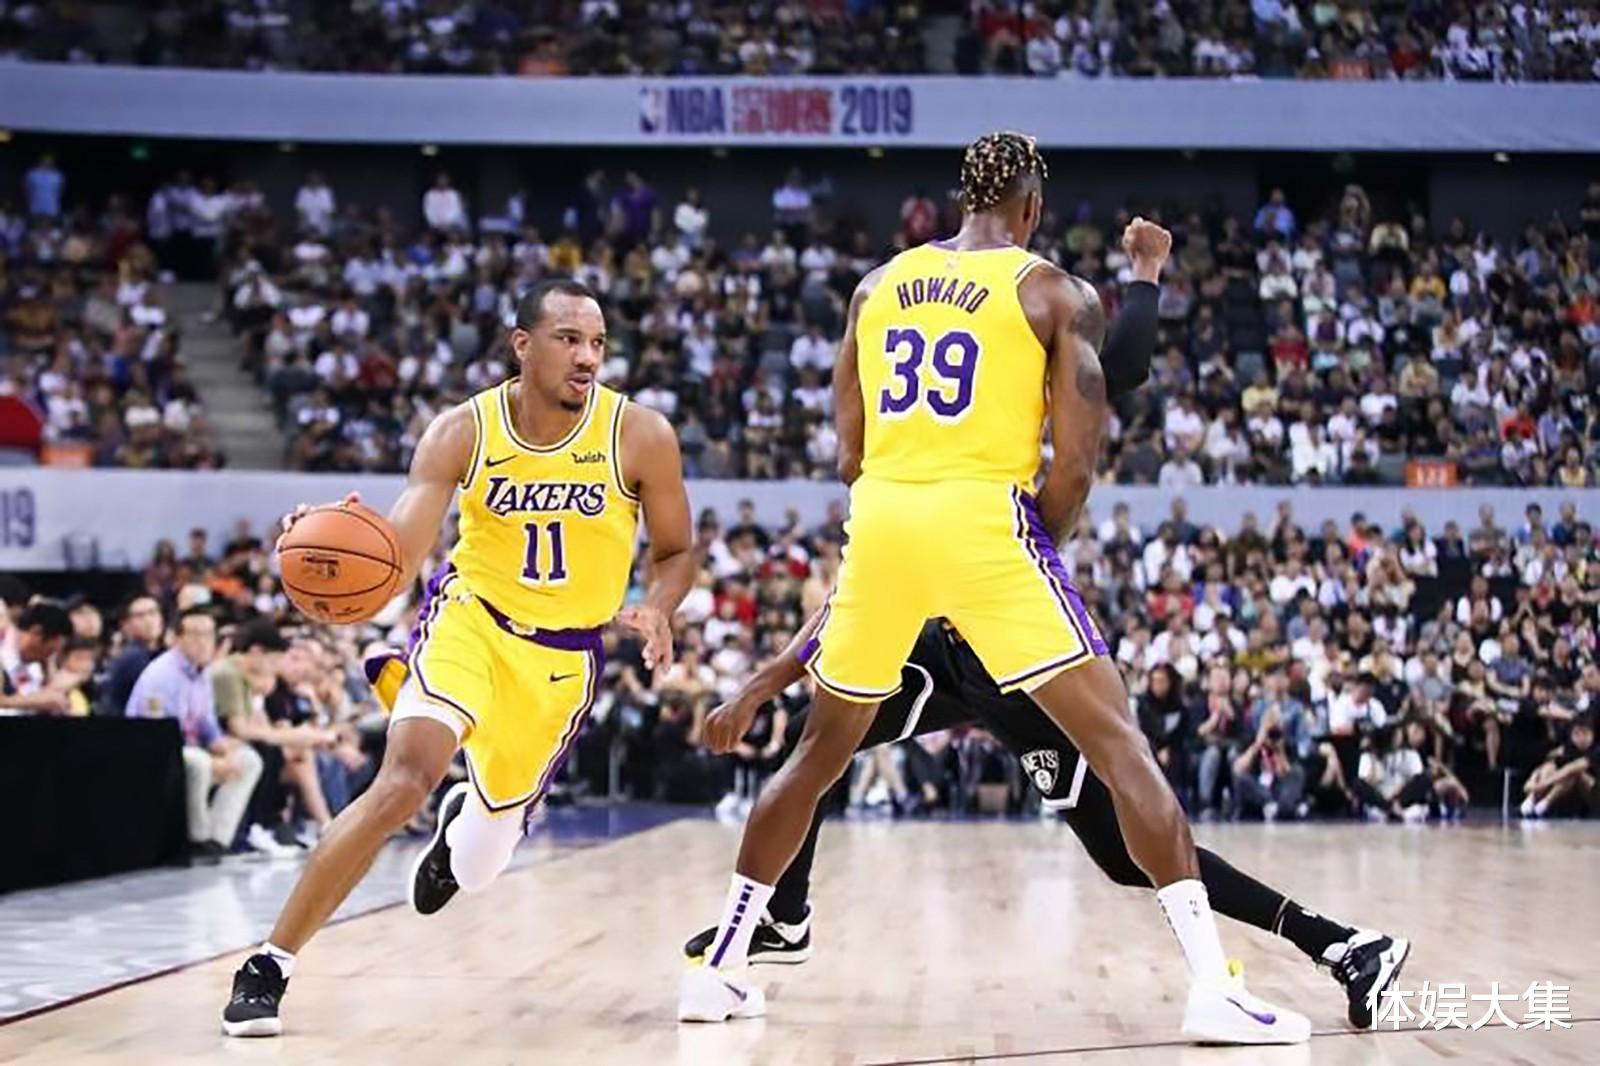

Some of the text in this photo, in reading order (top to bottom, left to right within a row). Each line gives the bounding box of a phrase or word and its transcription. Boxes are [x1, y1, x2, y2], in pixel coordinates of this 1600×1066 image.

[666, 87, 725, 133] NBA
[840, 86, 913, 134] 2019
[896, 276, 989, 314] HOWARD
[880, 329, 979, 417] 39
[571, 452, 606, 464] wish
[485, 477, 606, 516] LAKERS
[522, 521, 566, 580] 11
[1021, 750, 1057, 771] NETS
